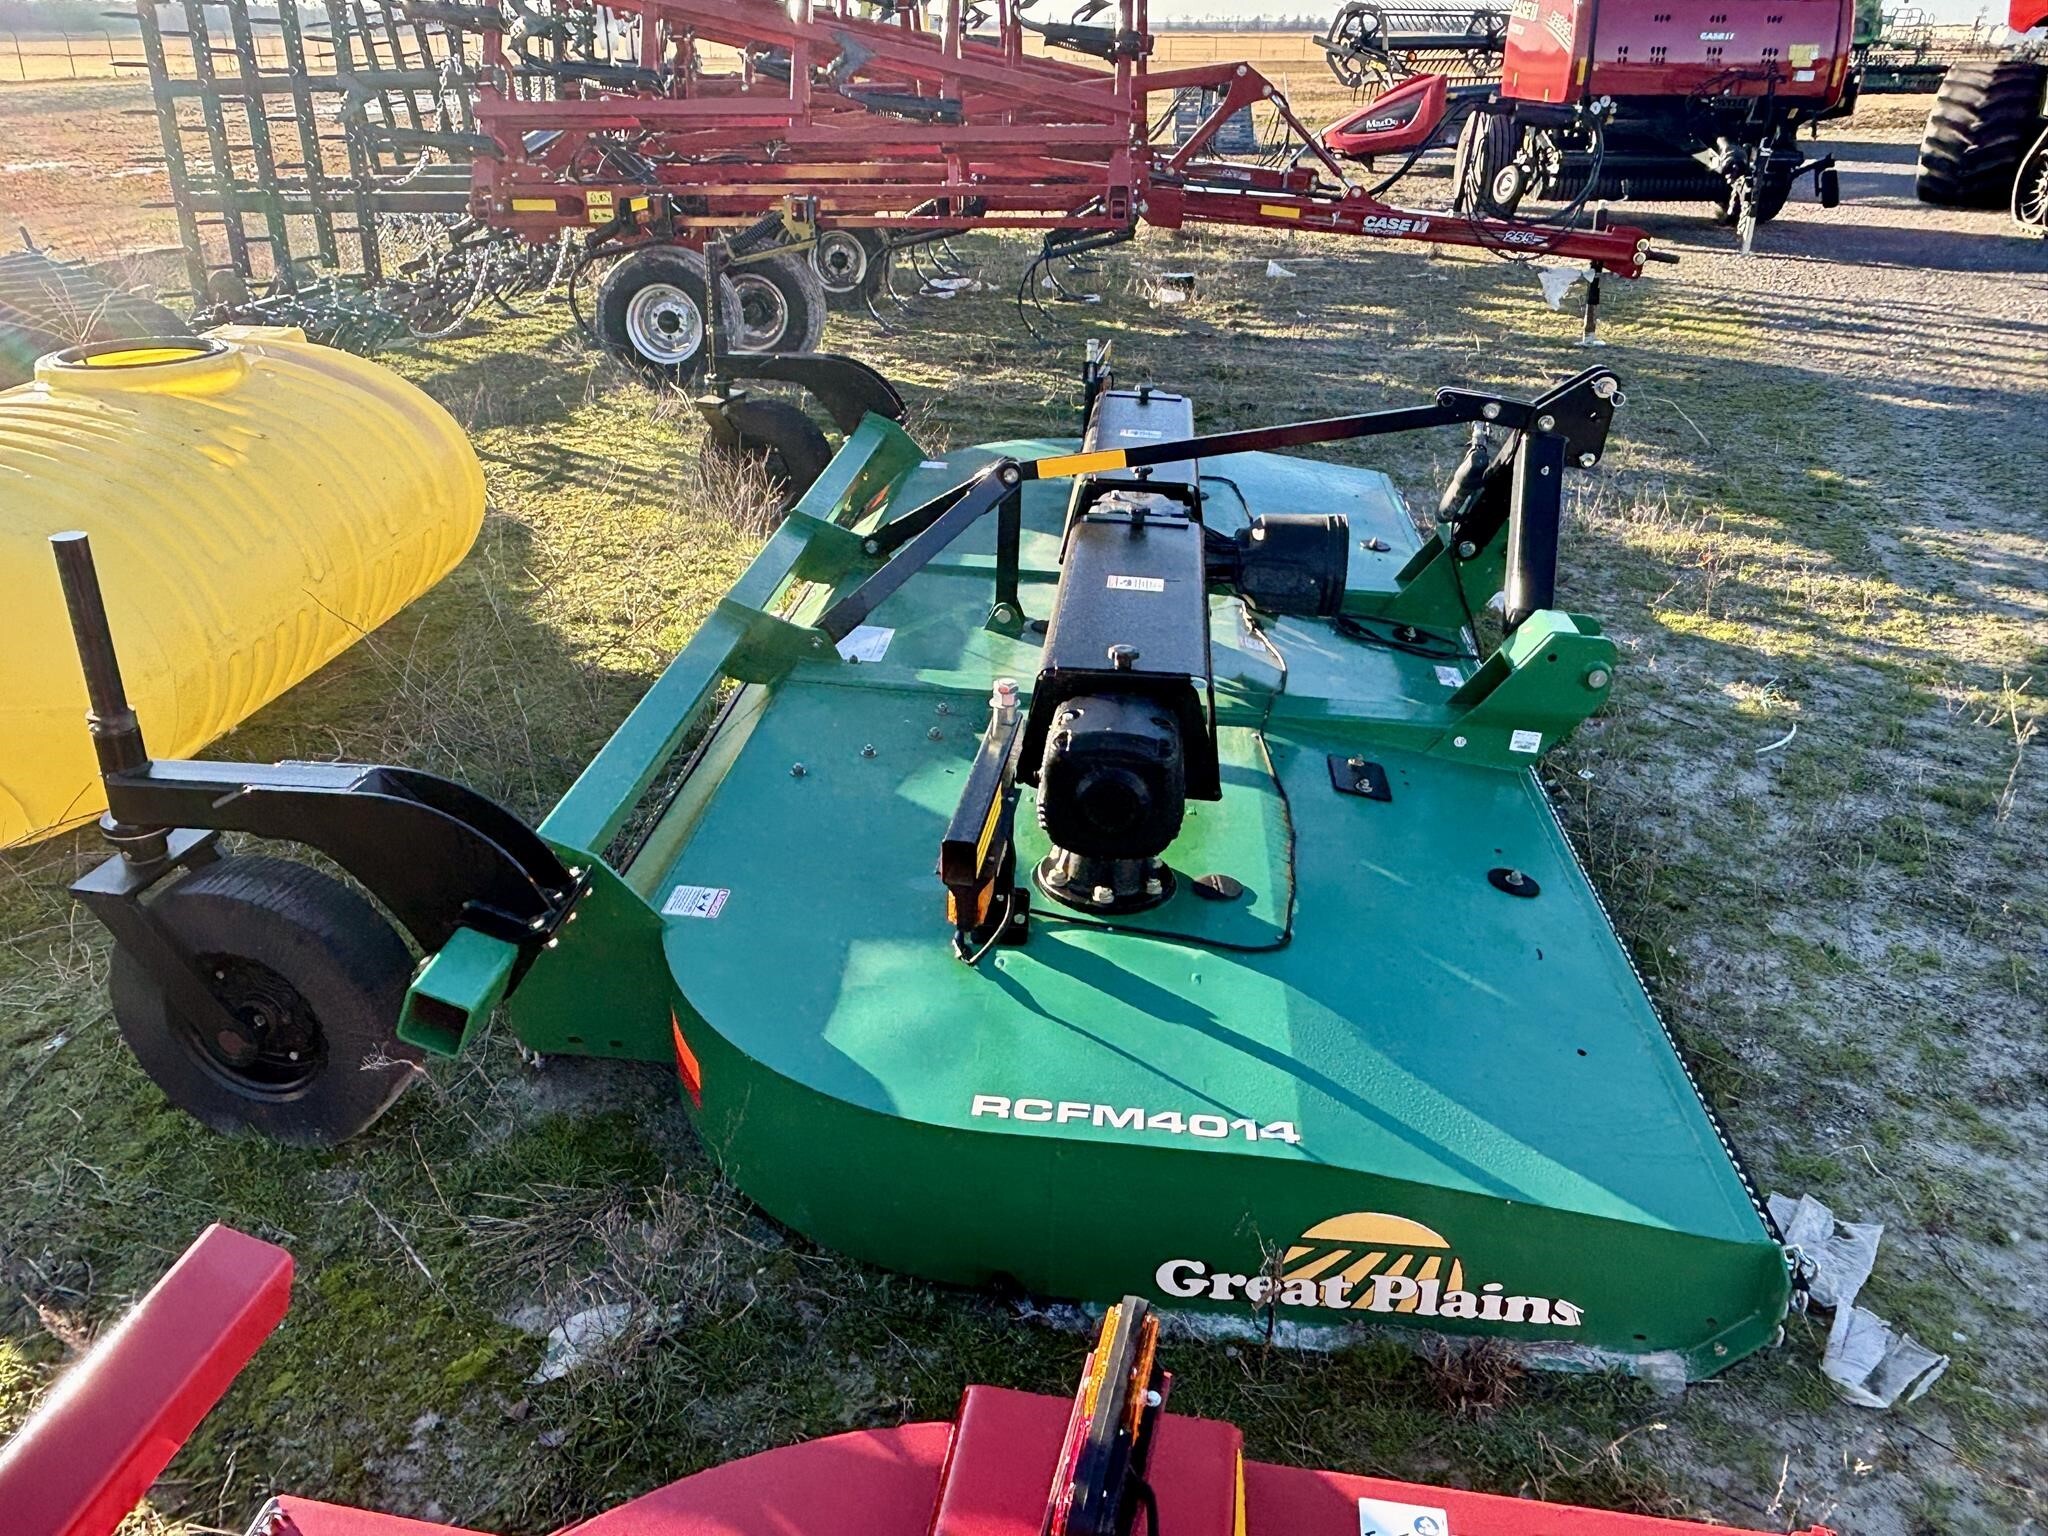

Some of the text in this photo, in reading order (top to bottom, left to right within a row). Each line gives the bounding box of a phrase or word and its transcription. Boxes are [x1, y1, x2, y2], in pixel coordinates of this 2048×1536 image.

[1363, 215, 1412, 232] CASE
[970, 1094, 1300, 1144] RCFM4014
[1155, 1259, 1584, 1326] Great Plains
